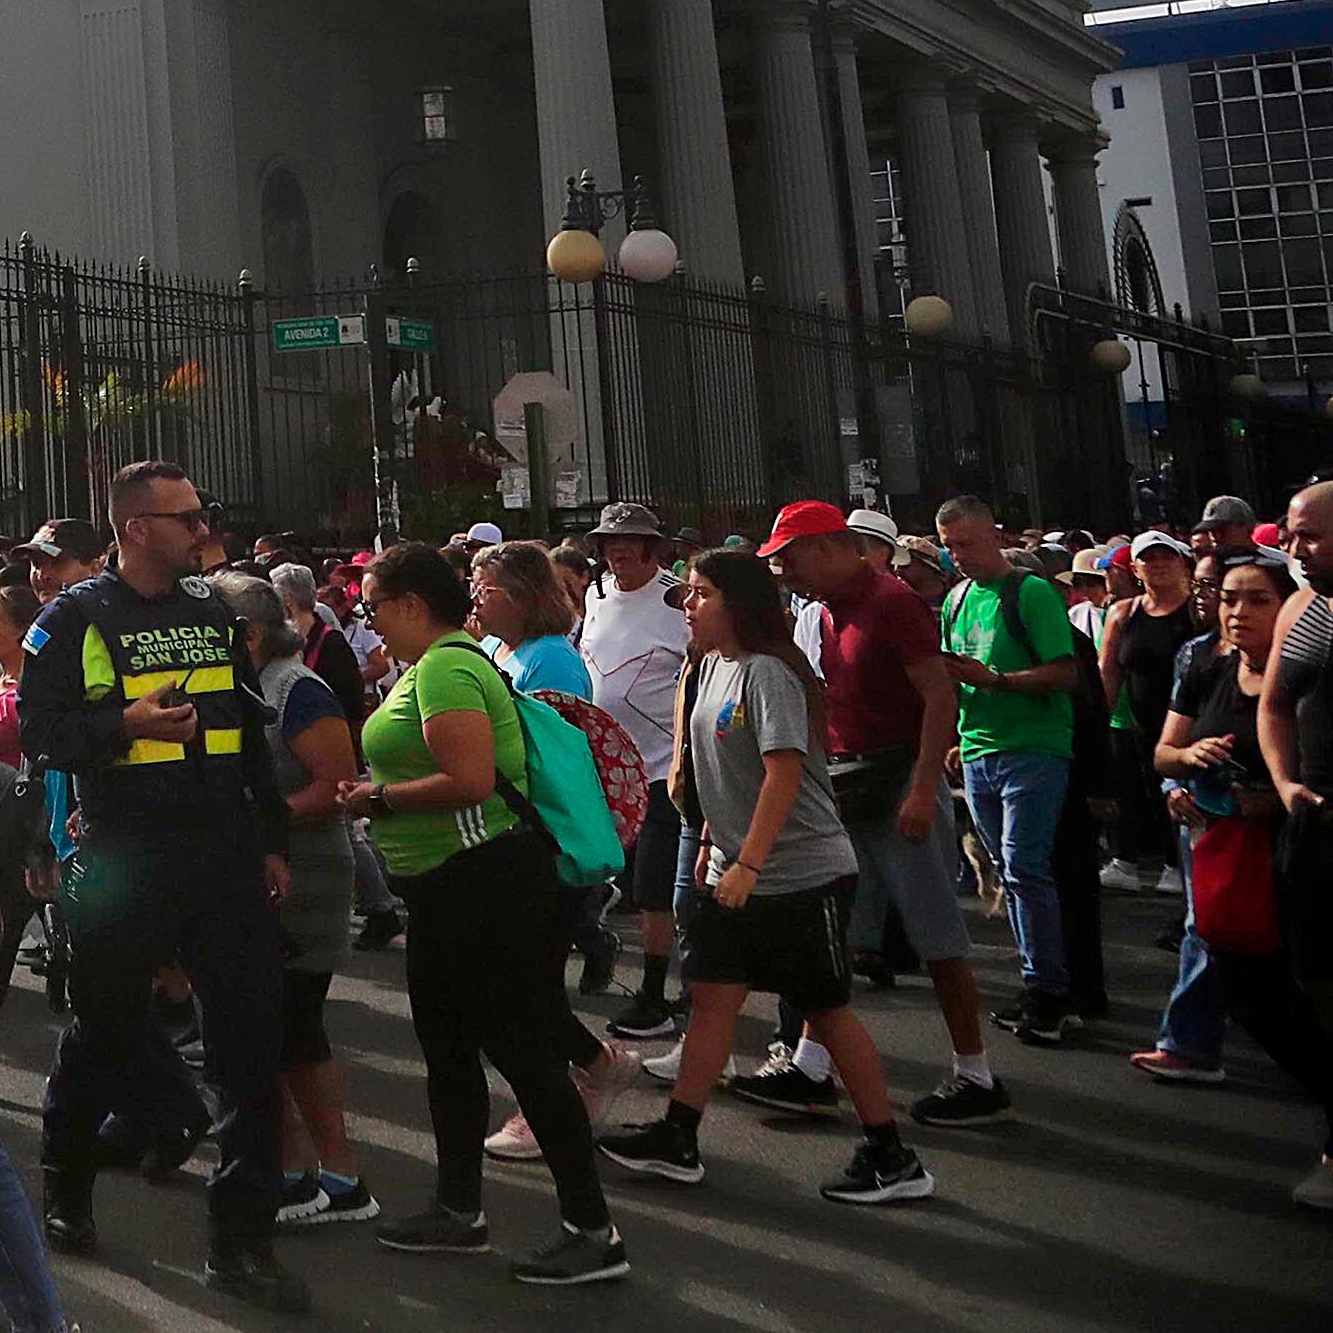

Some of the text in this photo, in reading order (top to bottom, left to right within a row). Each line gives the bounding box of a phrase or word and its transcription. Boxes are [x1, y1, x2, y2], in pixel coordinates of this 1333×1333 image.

[284, 328, 322, 341] AVENIDA
[323, 327, 329, 338] 2
[120, 626, 221, 648] POLICIA
[137, 639, 214, 654] MUNICIPAL
[130, 647, 230, 670] SAN JOSE
